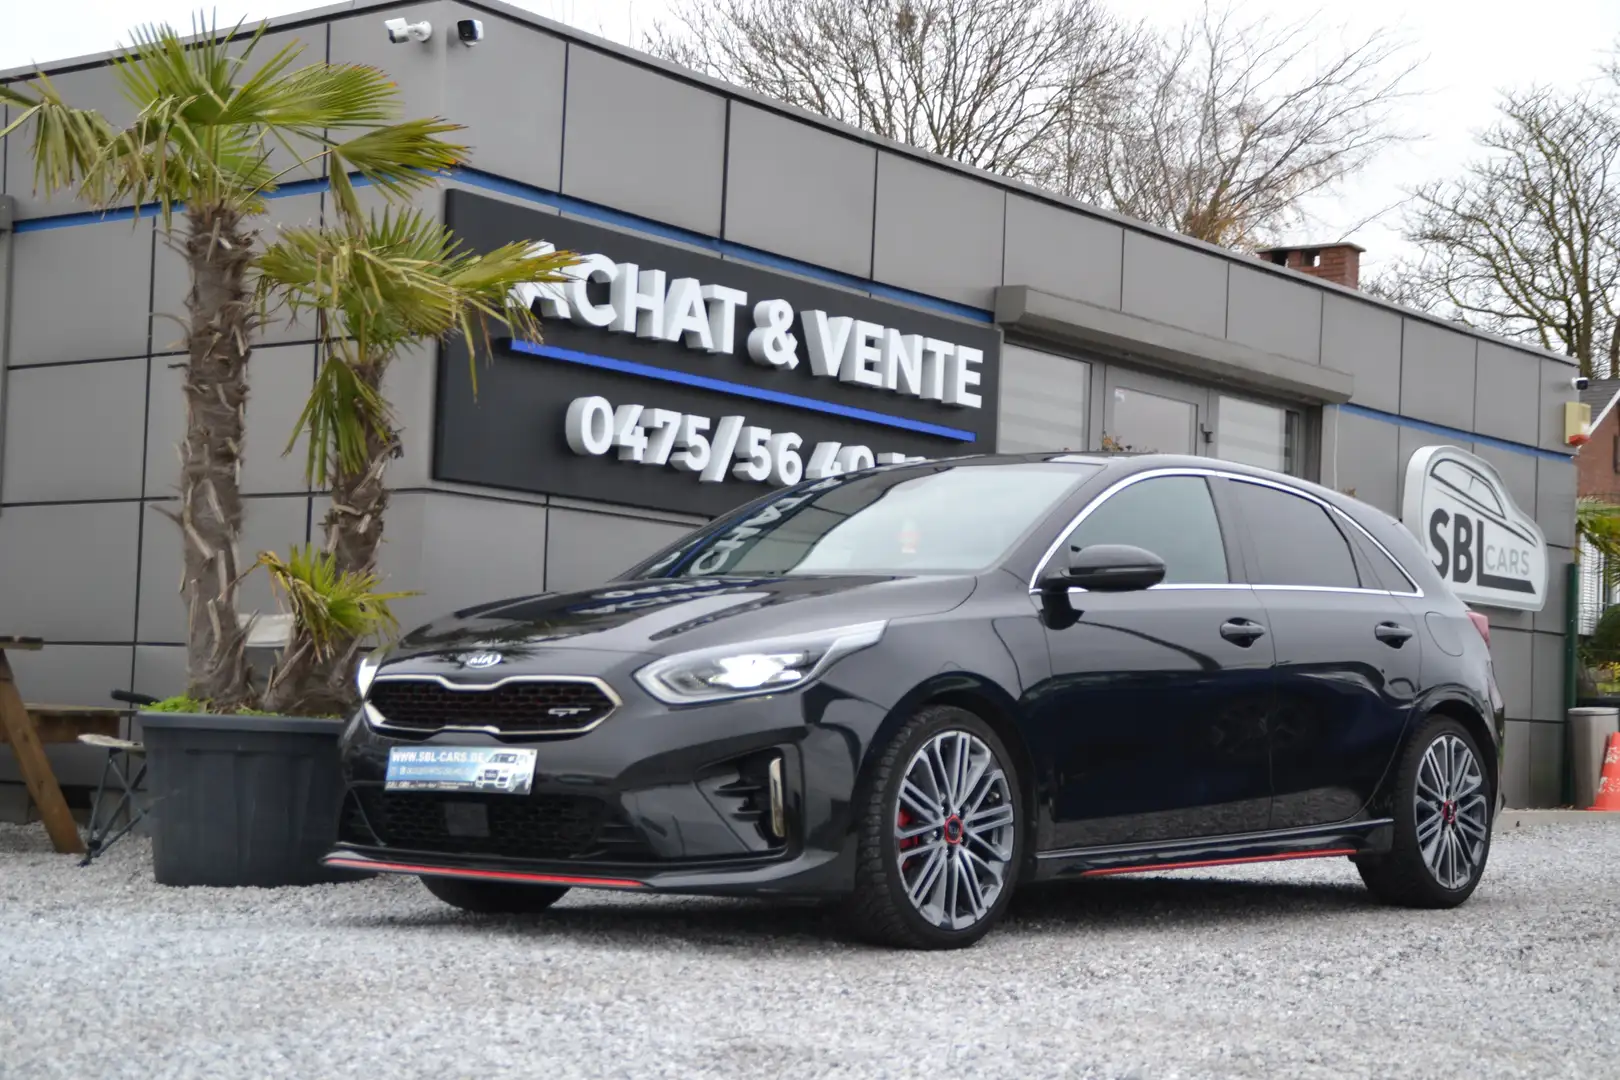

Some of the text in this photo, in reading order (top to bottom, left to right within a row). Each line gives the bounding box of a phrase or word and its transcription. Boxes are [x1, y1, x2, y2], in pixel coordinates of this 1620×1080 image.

[506, 241, 984, 409] ACHAT & VENTE
[565, 395, 804, 488] 0475/56
[1429, 508, 1537, 595] SBL CARS
